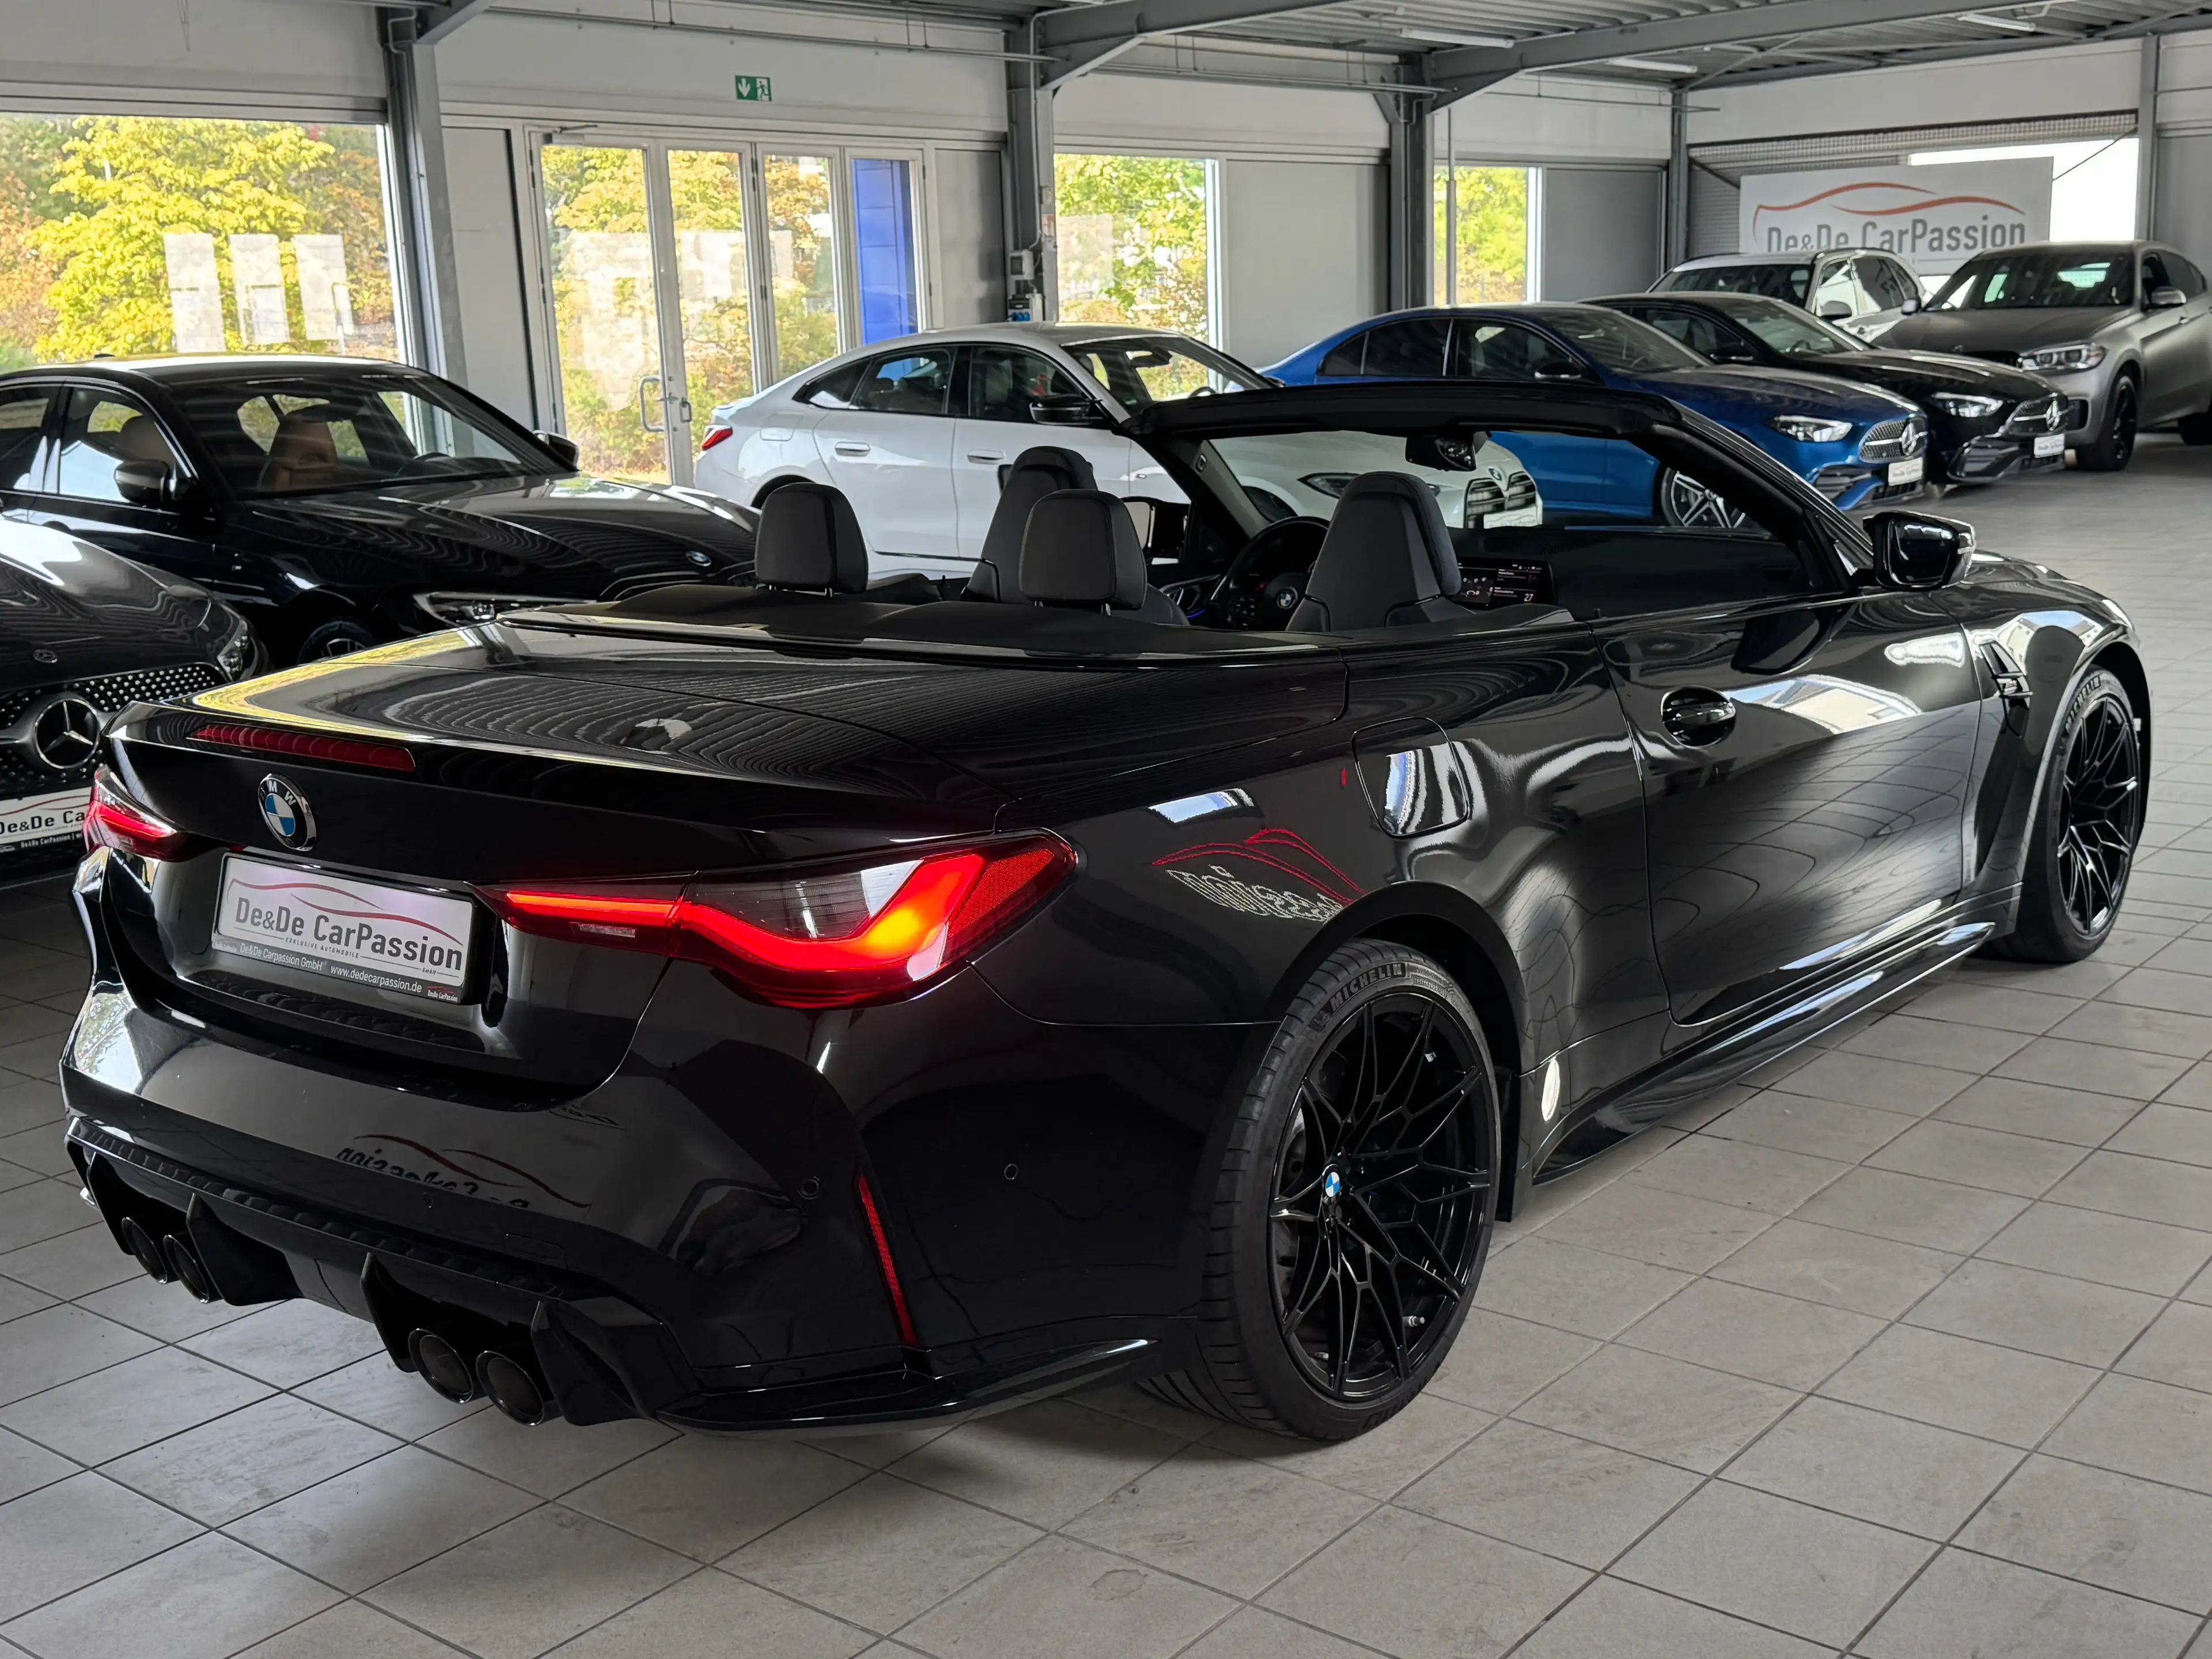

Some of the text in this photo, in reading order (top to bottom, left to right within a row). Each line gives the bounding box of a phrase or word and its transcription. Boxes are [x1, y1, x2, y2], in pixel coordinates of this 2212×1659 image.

[1767, 214, 2027, 253] De&De CarPassion
[235, 897, 463, 971] De&De CarPassion
[240, 943, 262, 957] De&De
[263, 948, 300, 966] Carpassion
[301, 957, 323, 971] GmbH
[320, 945, 359, 959] AUTOMOBILE
[331, 965, 422, 993] www.dedecarpassion.de
[1330, 964, 1402, 1012] MICHELIN
